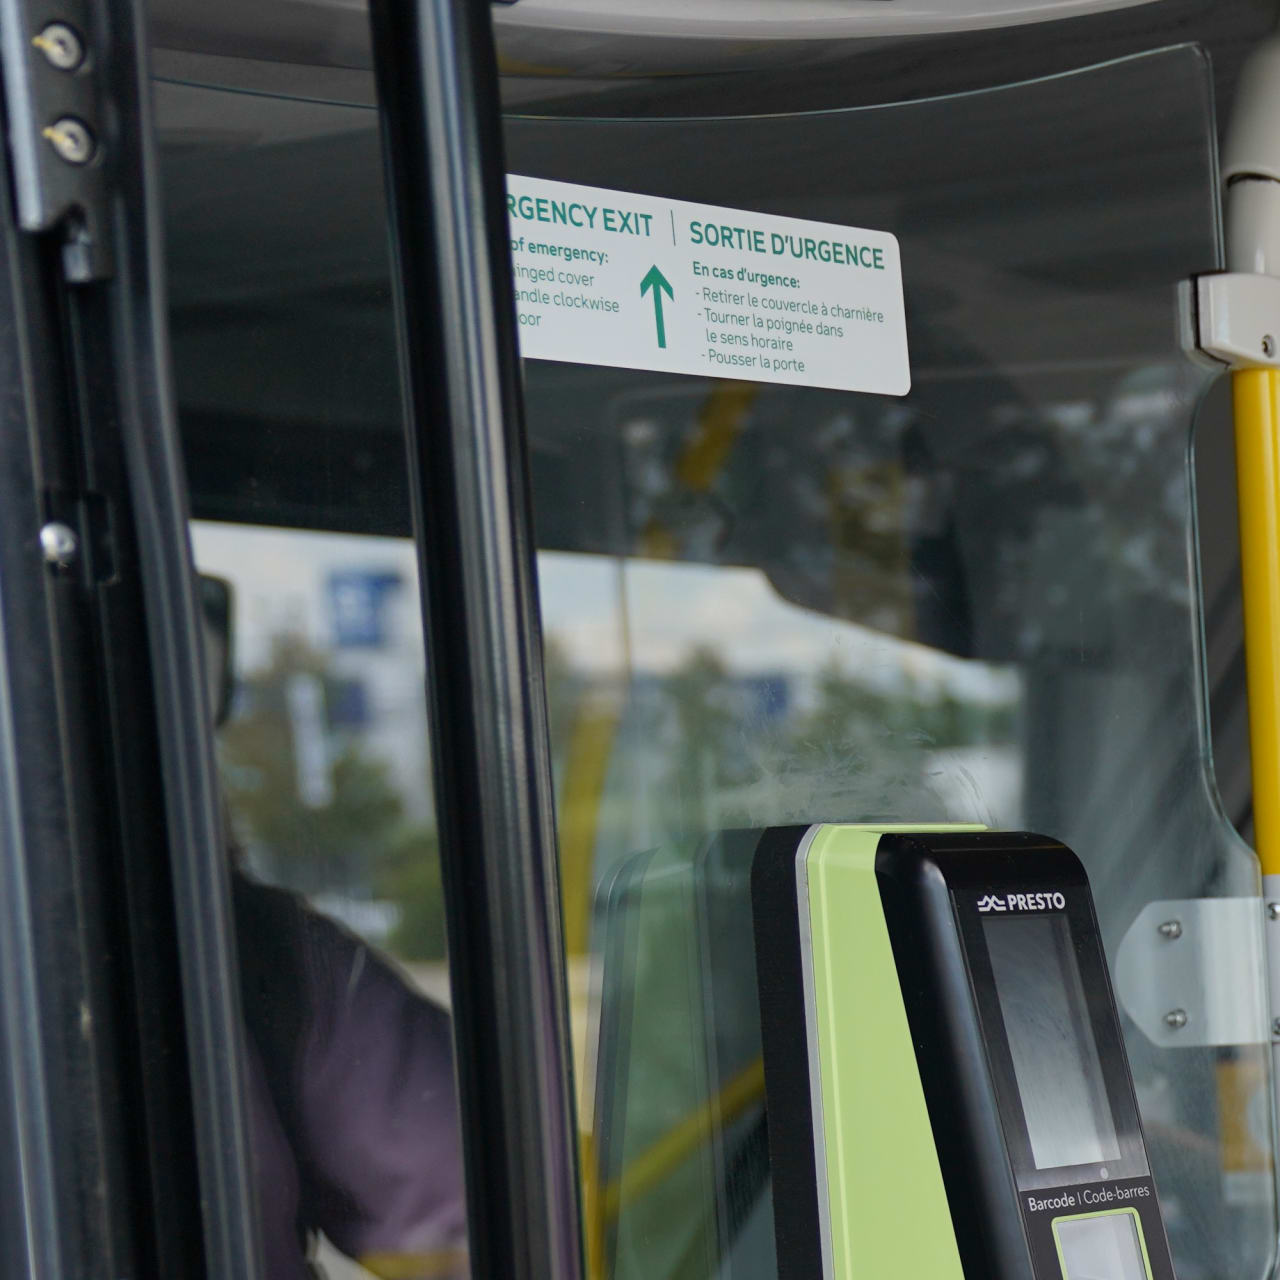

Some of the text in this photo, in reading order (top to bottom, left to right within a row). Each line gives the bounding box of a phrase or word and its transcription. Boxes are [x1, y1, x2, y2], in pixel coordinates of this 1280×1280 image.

[602, 208, 653, 237] EXIT
[510, 237, 609, 266] of emergency:
[690, 221, 885, 270] SORTIE D'URGENCE
[513, 263, 595, 287] inged cover
[693, 261, 800, 288] En cas d'urgence:
[553, 291, 620, 313] clockwise
[703, 287, 885, 323] Retirer le couvercle à charnière
[704, 307, 844, 337] Tourner la poignée dans
[706, 328, 793, 351] le sens horaire
[708, 349, 805, 372] Pousser la porte
[1006, 892, 1066, 911] PRESTO
[1028, 1185, 1150, 1212] Barcode Code-barres
